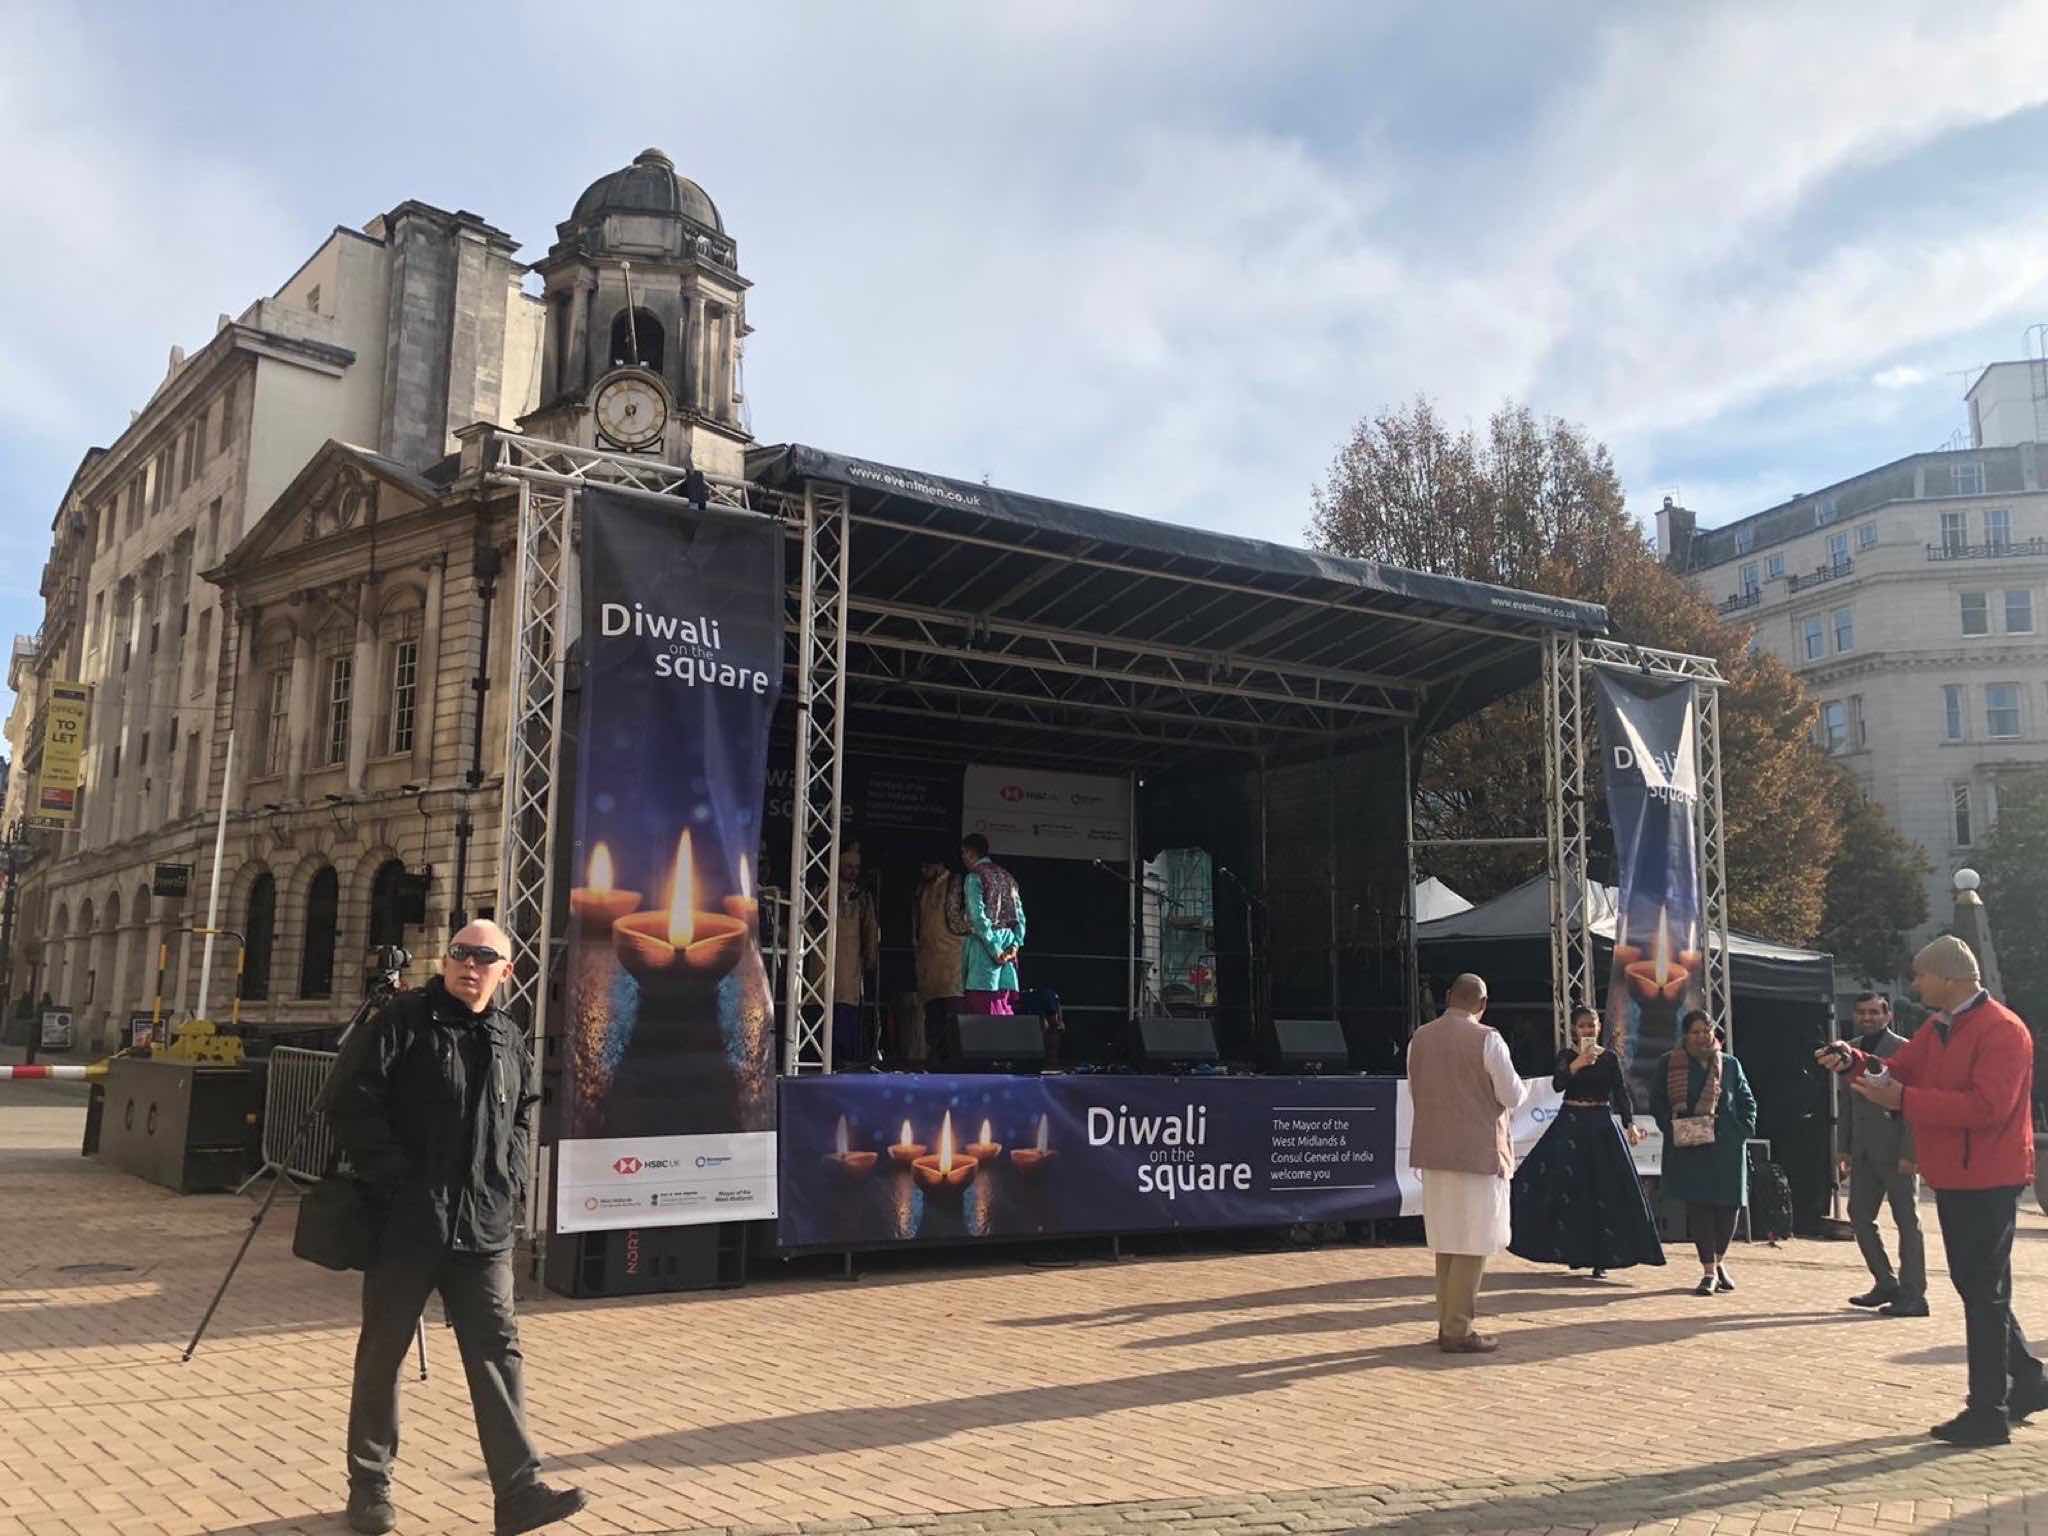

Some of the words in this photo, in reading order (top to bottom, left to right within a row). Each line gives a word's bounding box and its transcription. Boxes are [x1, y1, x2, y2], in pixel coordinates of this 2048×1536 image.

[849, 464, 981, 506] www.eventmen.co.uk
[601, 602, 721, 650] Diwali
[669, 643, 688, 656] on
[691, 644, 714, 661] the
[654, 653, 769, 694] square
[56, 719, 76, 731] TO
[52, 733, 77, 745] LET
[1087, 1104, 1206, 1146] Diwali
[1272, 1119, 1290, 1131] The
[1292, 1119, 1320, 1133] Mayor
[1321, 1118, 1333, 1131] of
[1334, 1119, 1350, 1131] the
[1272, 1136, 1296, 1147] West
[1298, 1134, 1338, 1147] Midlands
[1339, 1135, 1347, 1147] &
[1150, 1149, 1167, 1163] on
[1171, 1146, 1195, 1163] the
[1271, 1151, 1303, 1164] Consul
[1304, 1151, 1339, 1163] General
[1340, 1150, 1352, 1163] of
[1352, 1150, 1375, 1163] India
[643, 1159, 668, 1169] HSBC
[1138, 1163, 1252, 1200] square
[1270, 1168, 1312, 1180] welcome
[1312, 1169, 1331, 1182] you
